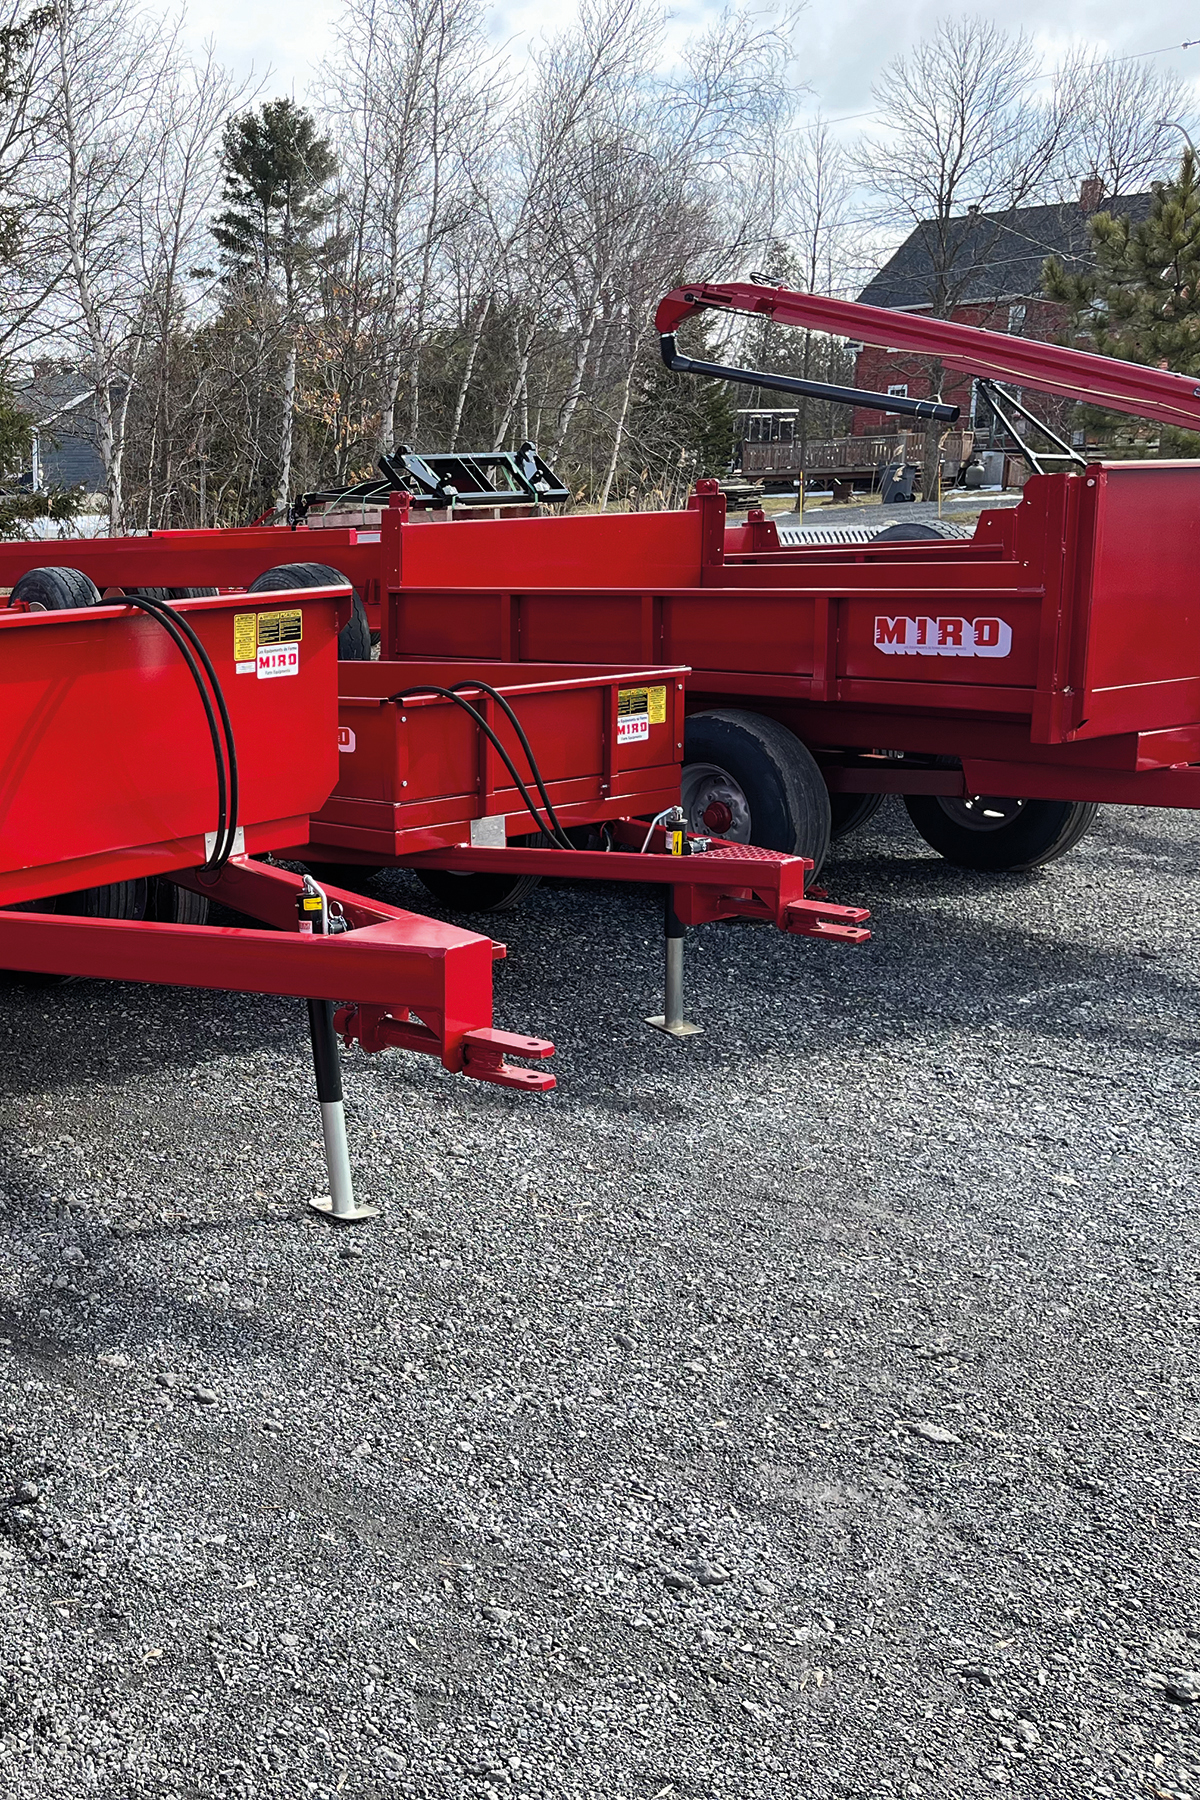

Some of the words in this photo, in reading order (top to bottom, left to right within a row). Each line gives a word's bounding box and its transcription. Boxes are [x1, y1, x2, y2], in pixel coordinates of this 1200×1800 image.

[875, 617, 1002, 647] MIRO
[259, 653, 297, 669] MIRO
[617, 722, 647, 735] MIRO
